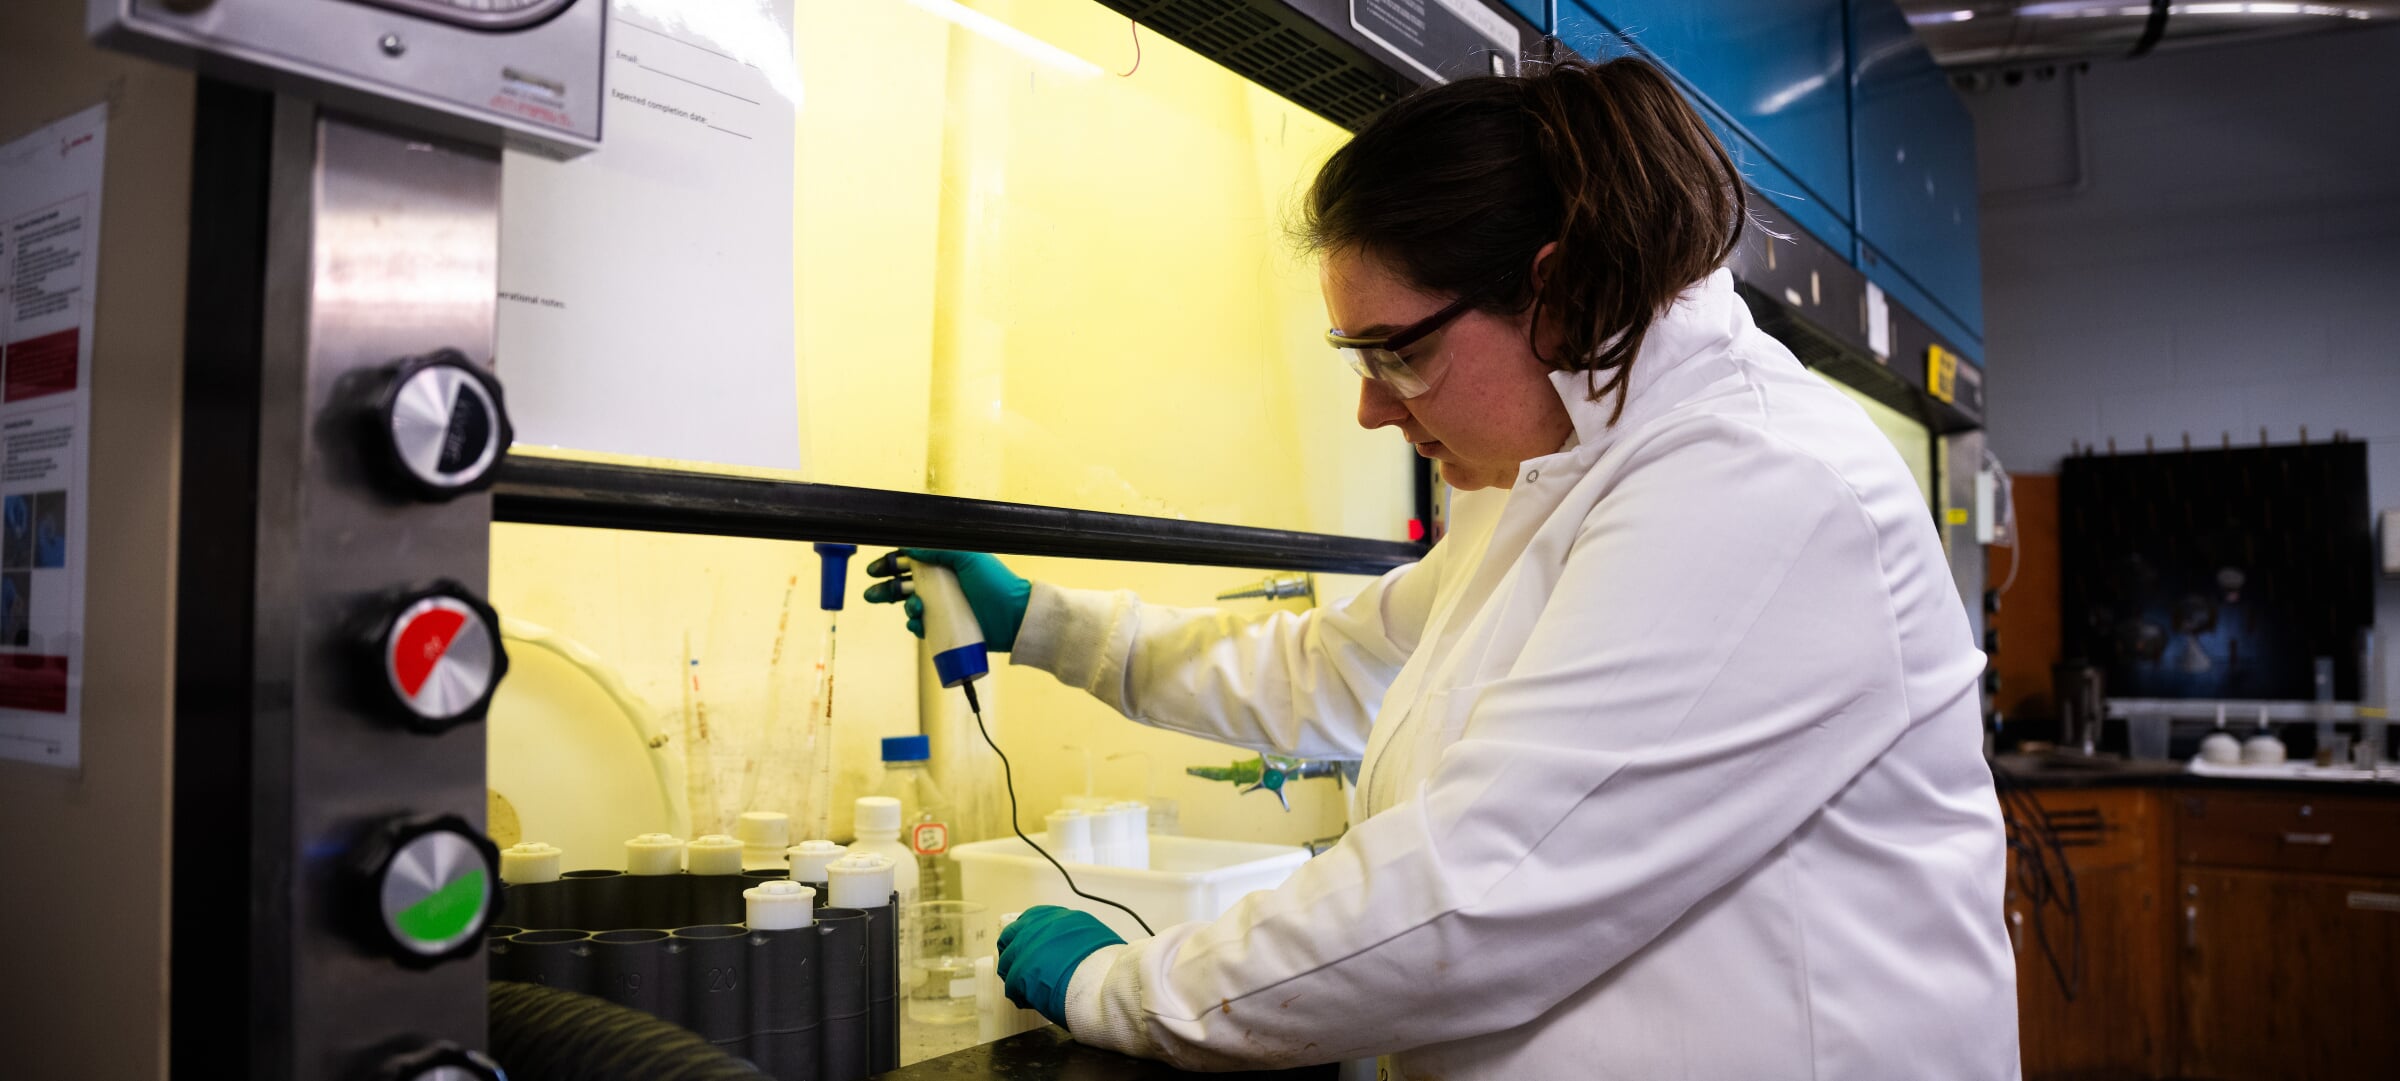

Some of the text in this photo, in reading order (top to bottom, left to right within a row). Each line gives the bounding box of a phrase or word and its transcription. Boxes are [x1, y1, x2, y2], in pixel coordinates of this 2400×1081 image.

[611, 88, 646, 106] Expected
[647, 100, 689, 118] completion
[708, 967, 737, 993] 20
